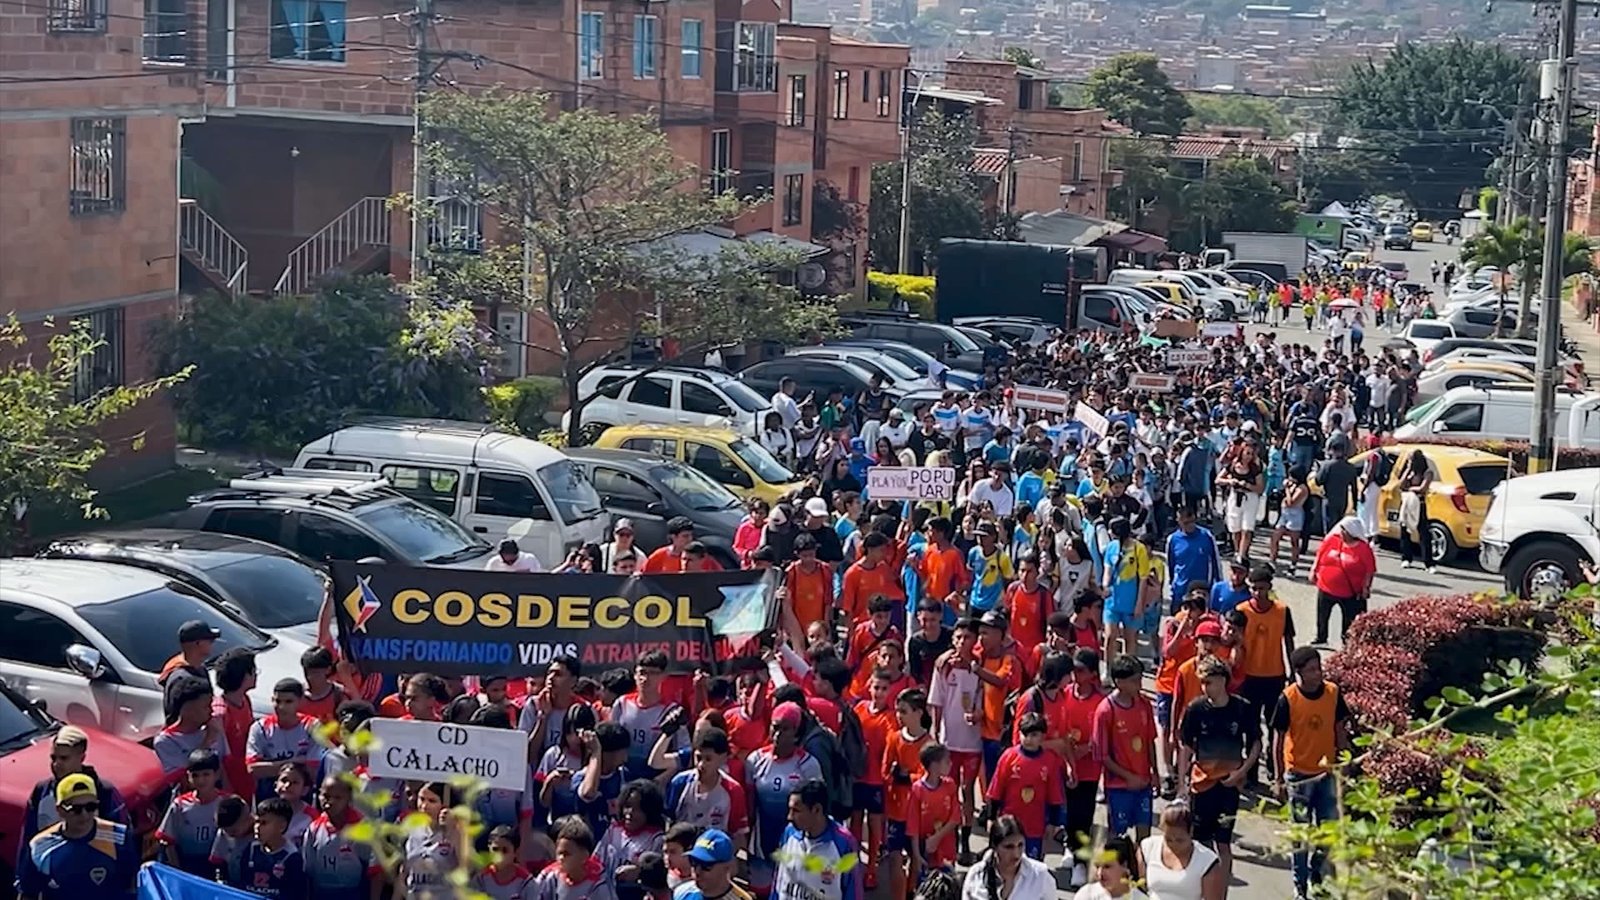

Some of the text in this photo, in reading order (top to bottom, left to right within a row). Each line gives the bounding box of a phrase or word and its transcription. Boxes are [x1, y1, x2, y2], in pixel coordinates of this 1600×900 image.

[910, 469, 953, 485] POPU
[919, 484, 944, 499] LAR
[391, 589, 707, 629] COSDECOL
[350, 638, 514, 665] RANSFORMANDO
[518, 643, 578, 665] VIDAS
[438, 726, 468, 746] CD
[633, 729, 646, 744] 19
[386, 746, 499, 778] CALACHO
[773, 777, 782, 792] 9
[195, 826, 210, 843] 10
[323, 855, 337, 871] 14
